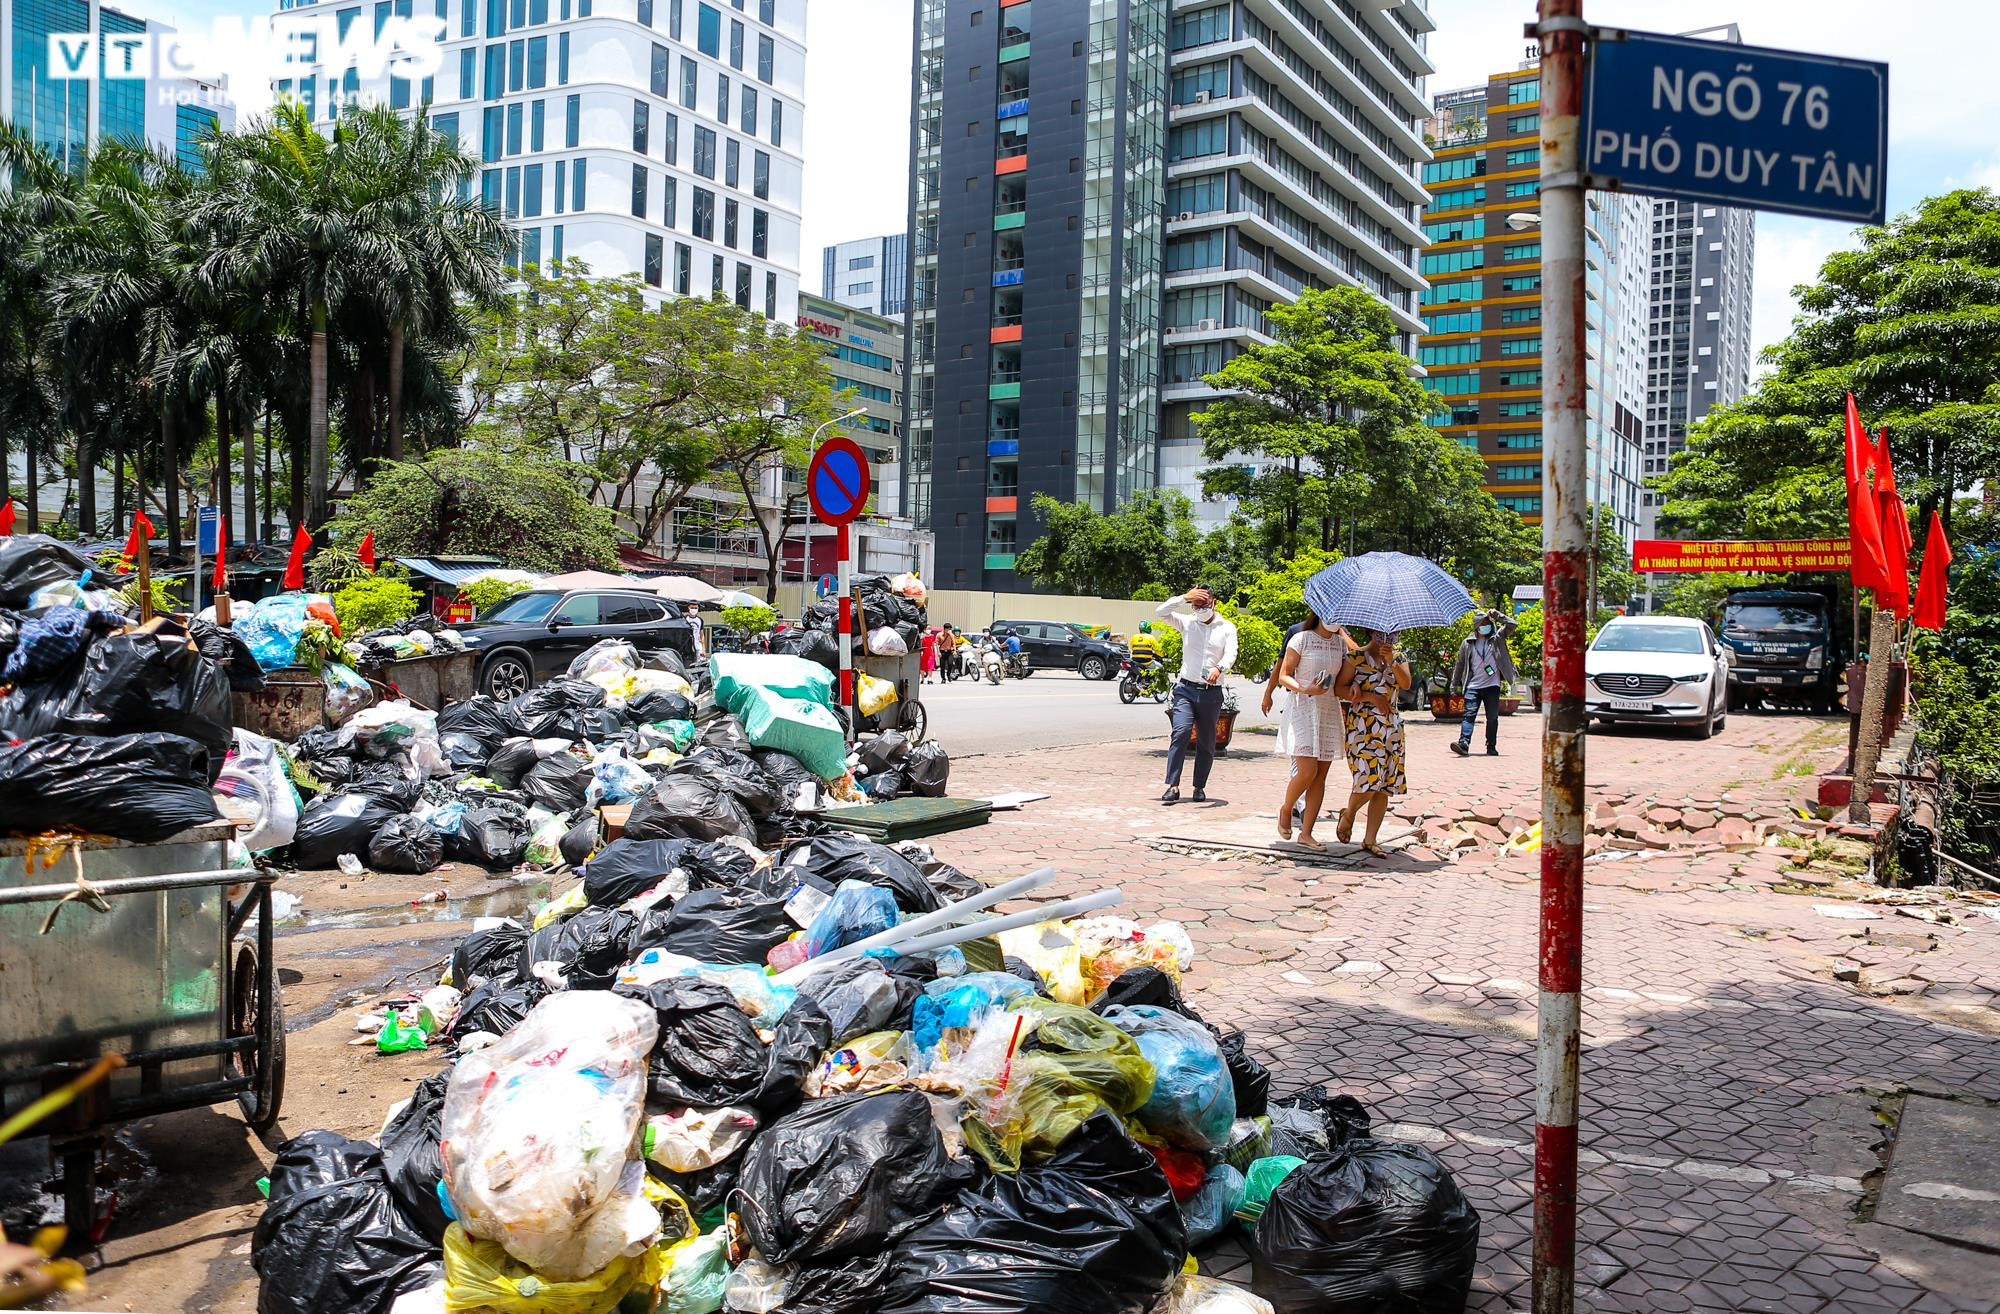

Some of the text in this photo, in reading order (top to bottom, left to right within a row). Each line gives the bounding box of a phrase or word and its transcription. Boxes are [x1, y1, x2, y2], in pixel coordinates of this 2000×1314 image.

[1652, 63, 1829, 130] NGÕ 76
[1593, 126, 1873, 200] PHỐ DUY TÂN
[1652, 556, 1678, 568] THÁNG
[1680, 556, 1702, 568] HÀNH
[1741, 557, 1753, 567] AN
[1795, 556, 1816, 566] SINH
[1818, 555, 1835, 566] LAO
[1837, 553, 1852, 567] ĐỘ
